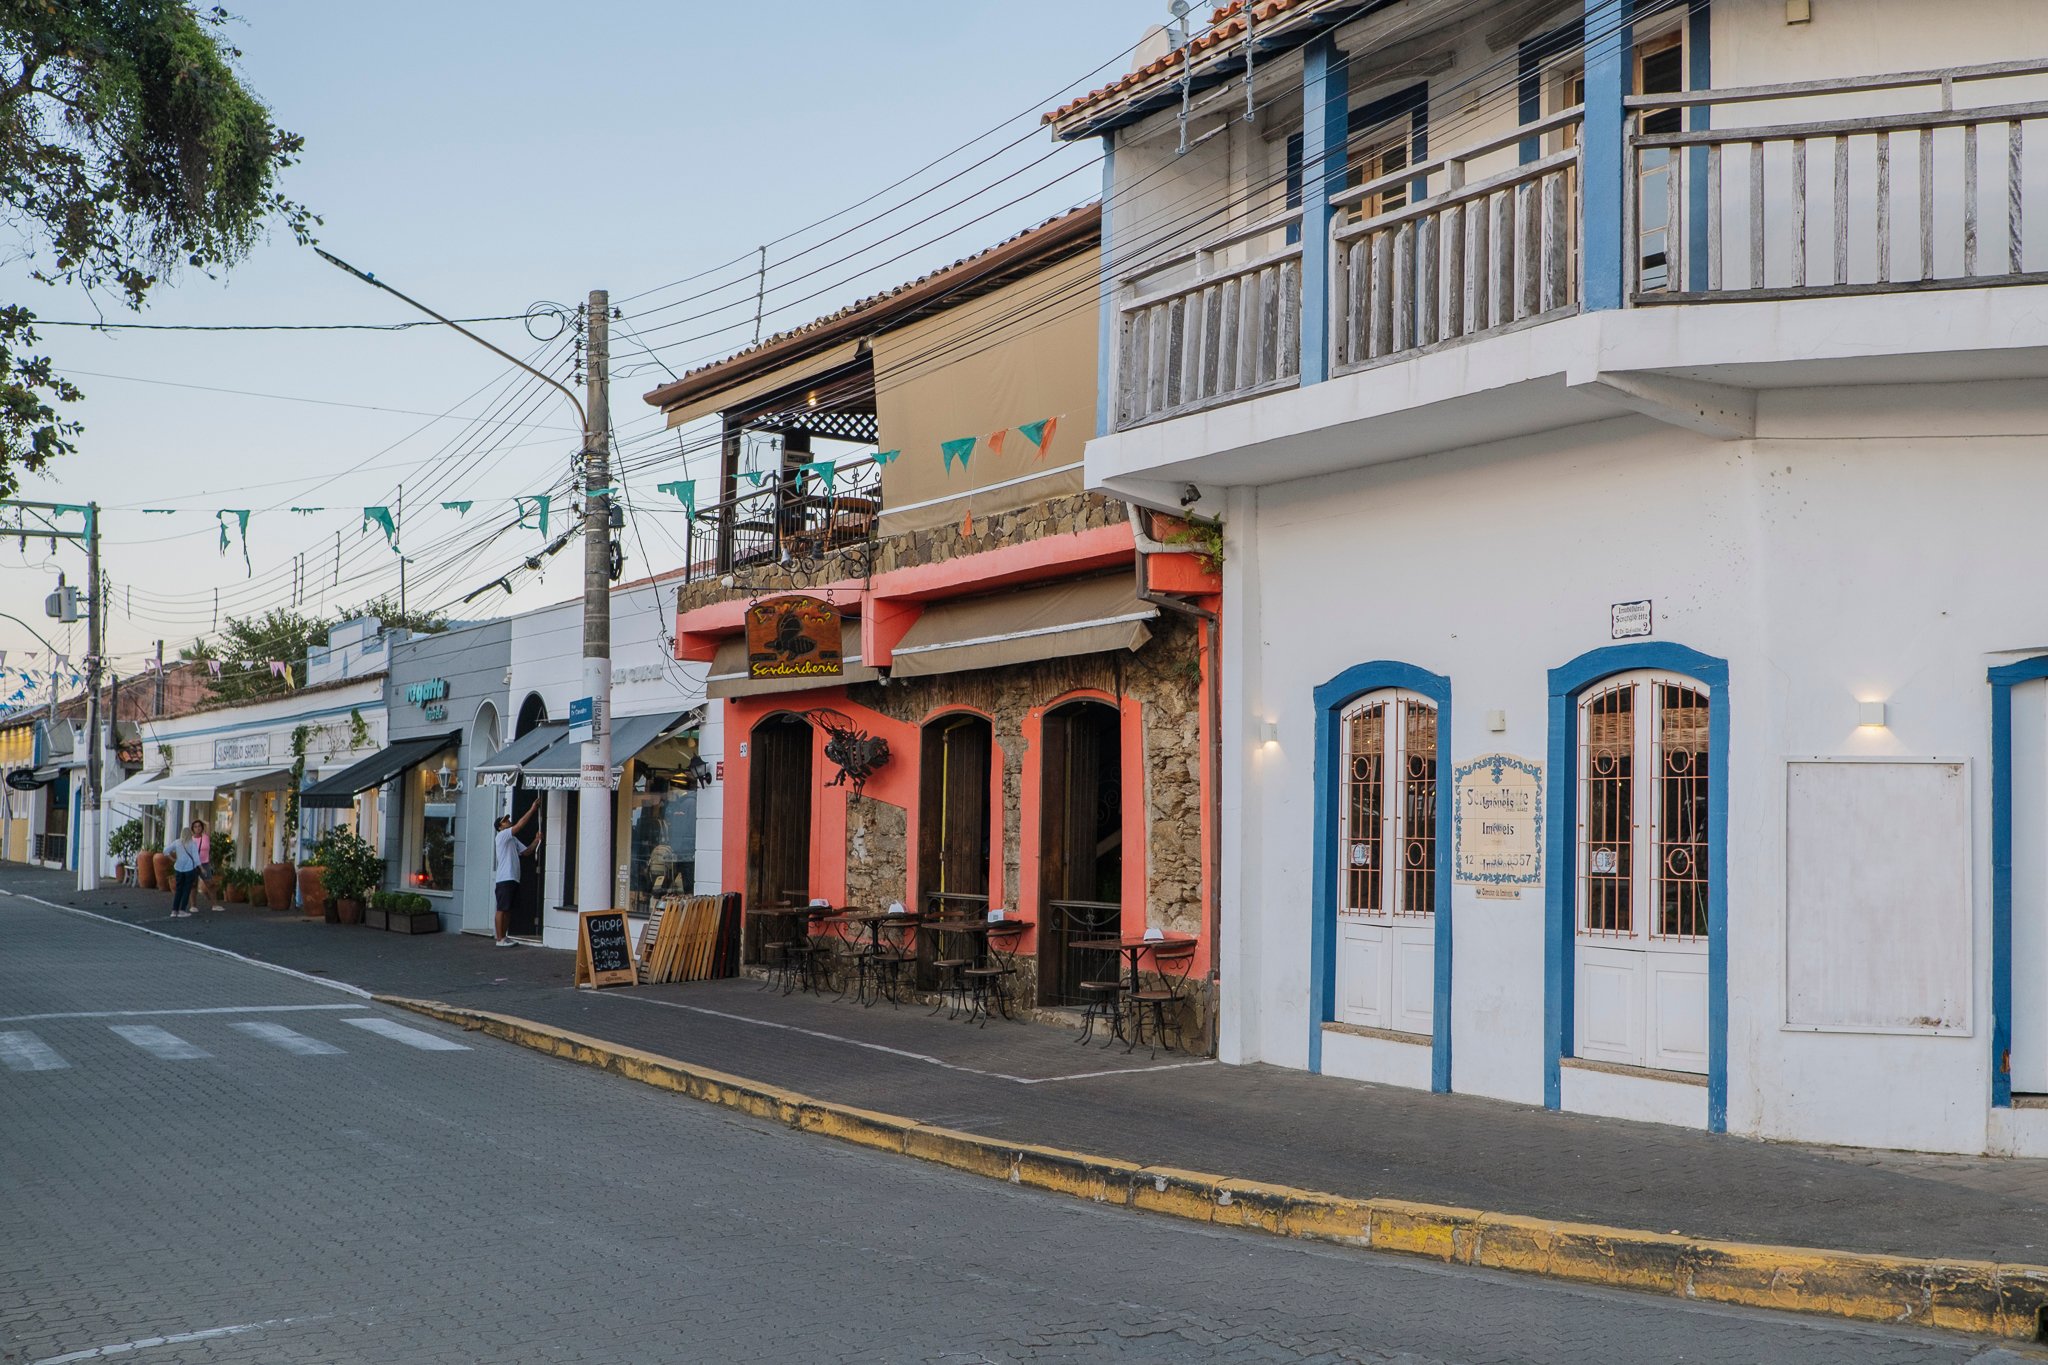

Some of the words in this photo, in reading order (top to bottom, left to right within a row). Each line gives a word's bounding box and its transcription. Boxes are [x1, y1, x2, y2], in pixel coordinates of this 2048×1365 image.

[1643, 622, 1648, 631] 2
[1482, 822, 1514, 836] Imóveis
[1464, 854, 1474, 865] 12
[591, 919, 623, 932] CHOPP
